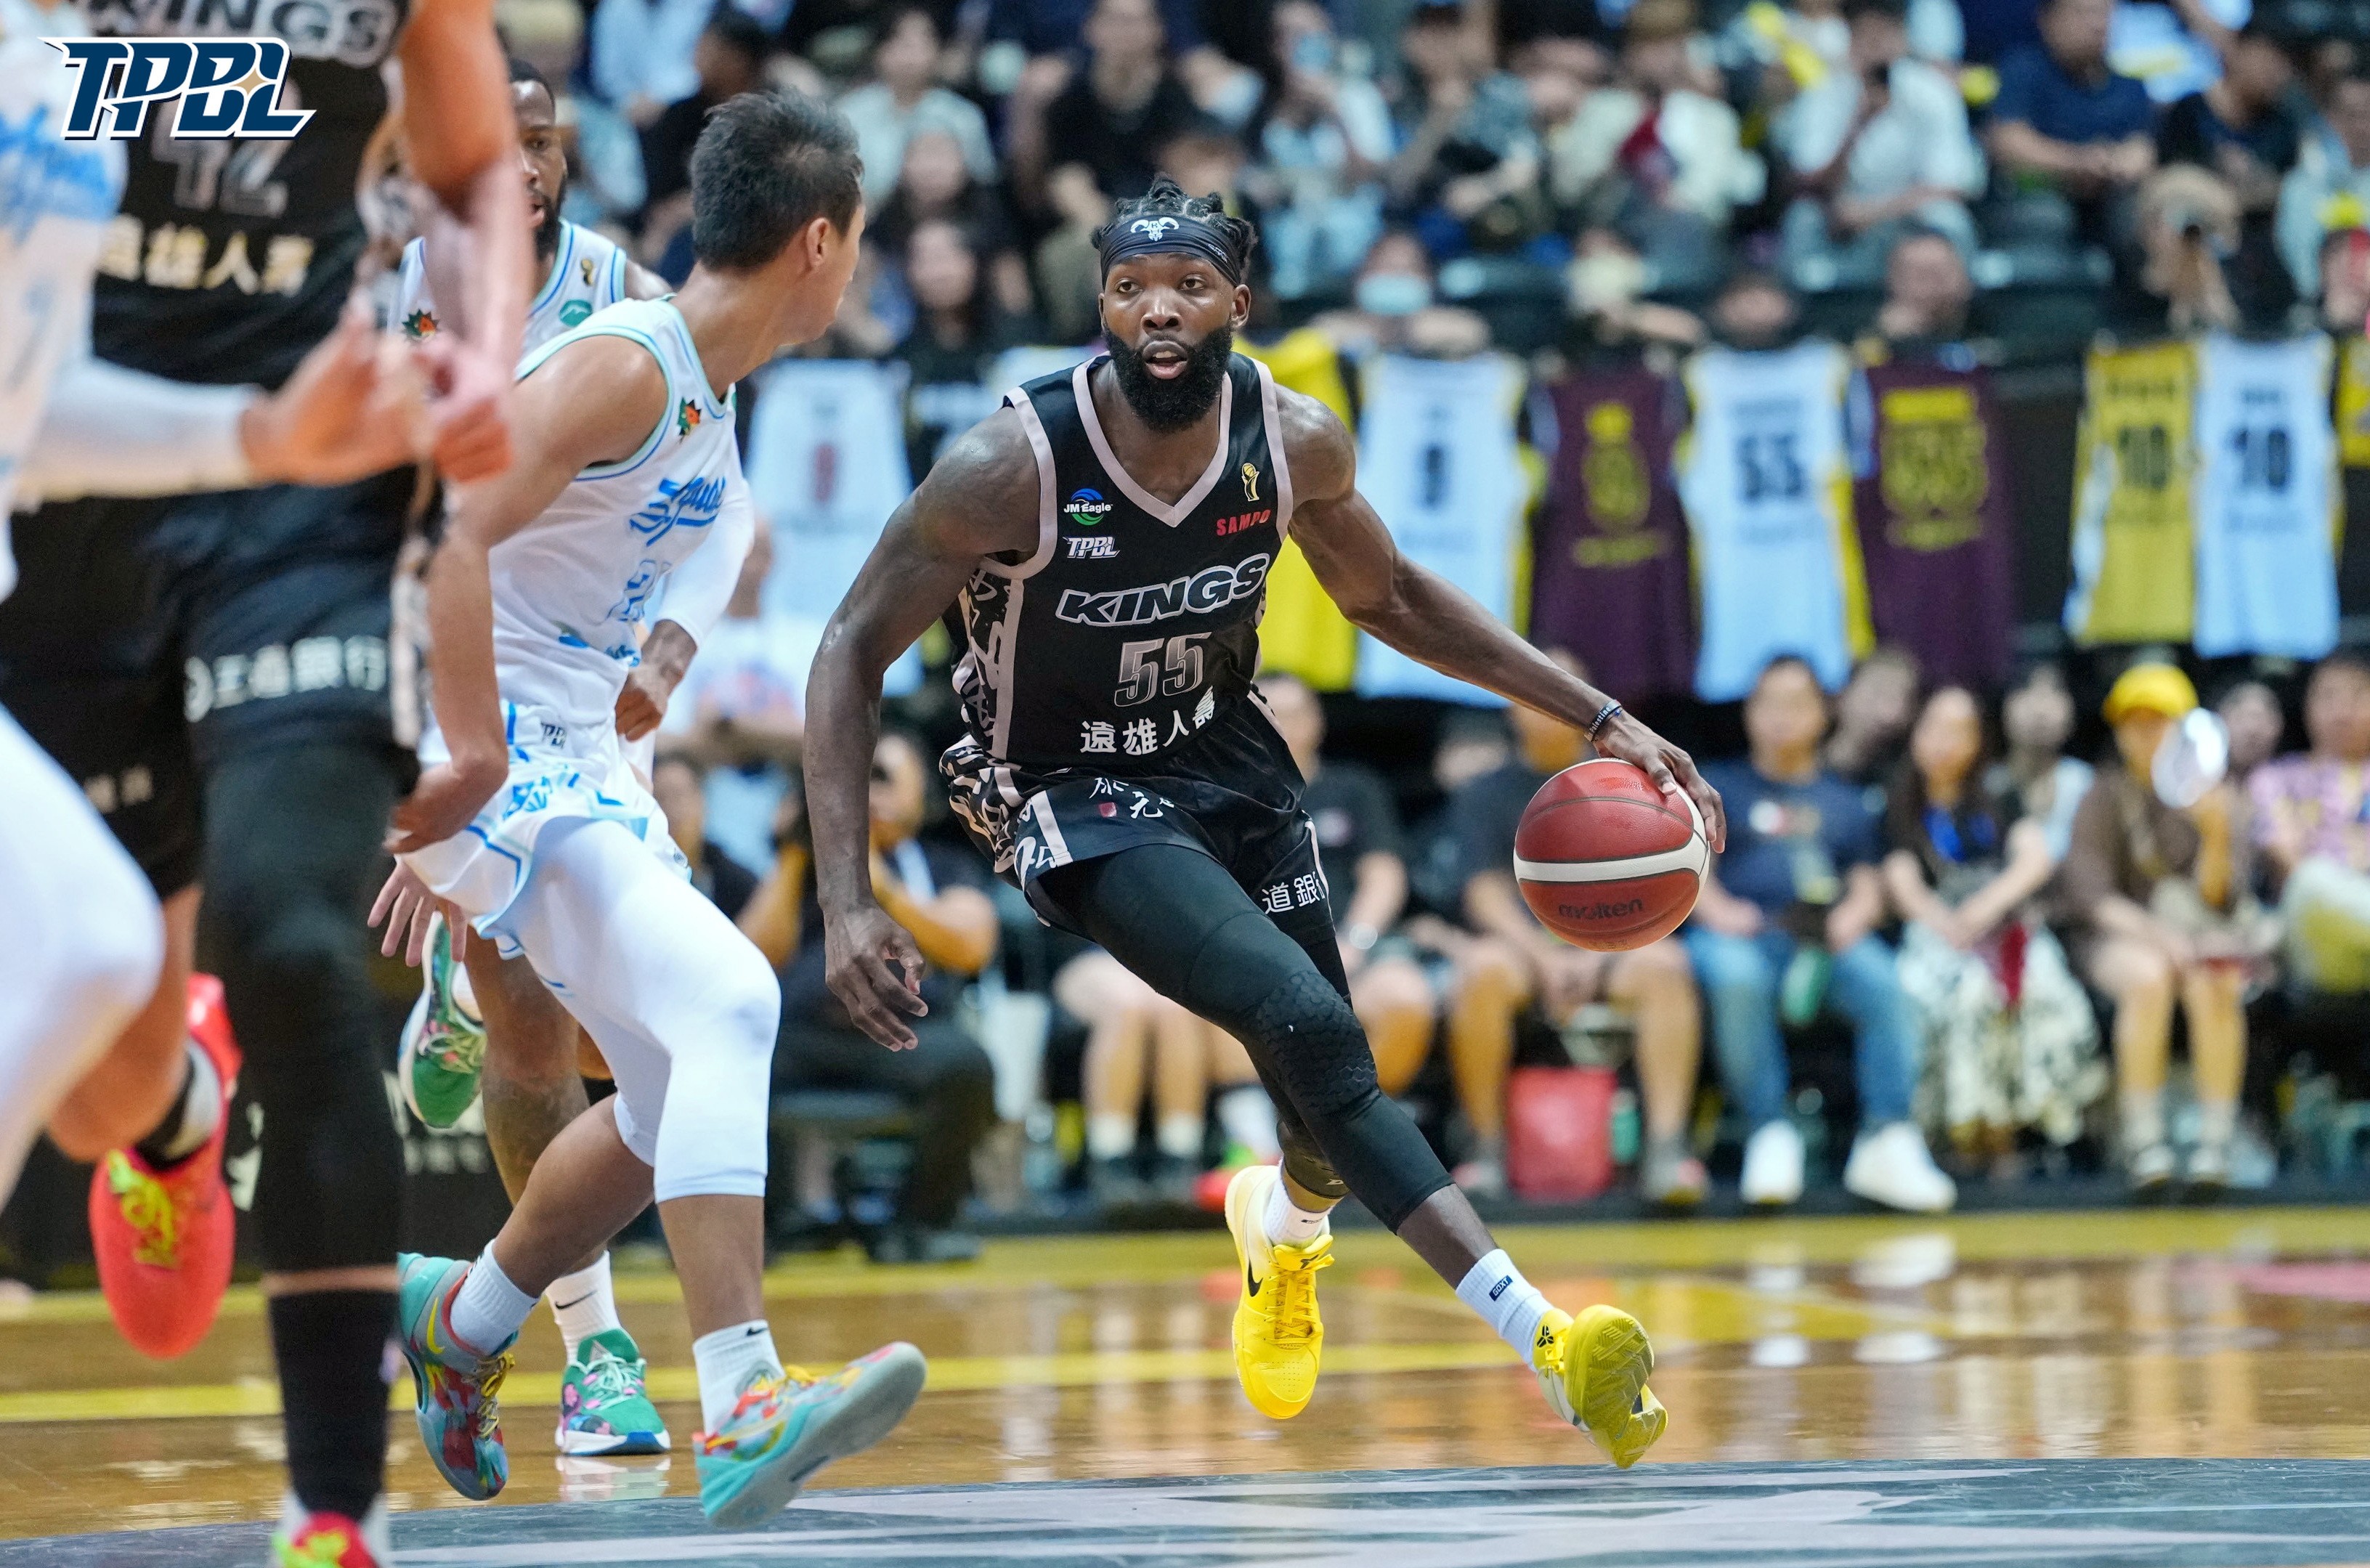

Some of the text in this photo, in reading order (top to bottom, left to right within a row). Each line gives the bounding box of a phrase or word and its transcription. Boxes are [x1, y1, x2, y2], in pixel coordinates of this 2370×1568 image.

[1063, 501, 1112, 514] JM Eagle
[1216, 509, 1271, 536] SAMPO
[1063, 536, 1121, 559] TPBL
[1055, 553, 1270, 627] KINGS
[1113, 631, 1213, 707] 55
[1079, 686, 1216, 756] 遠雄人壽
[1588, 706, 1612, 734] Palestine
[1558, 898, 1644, 921] molten
